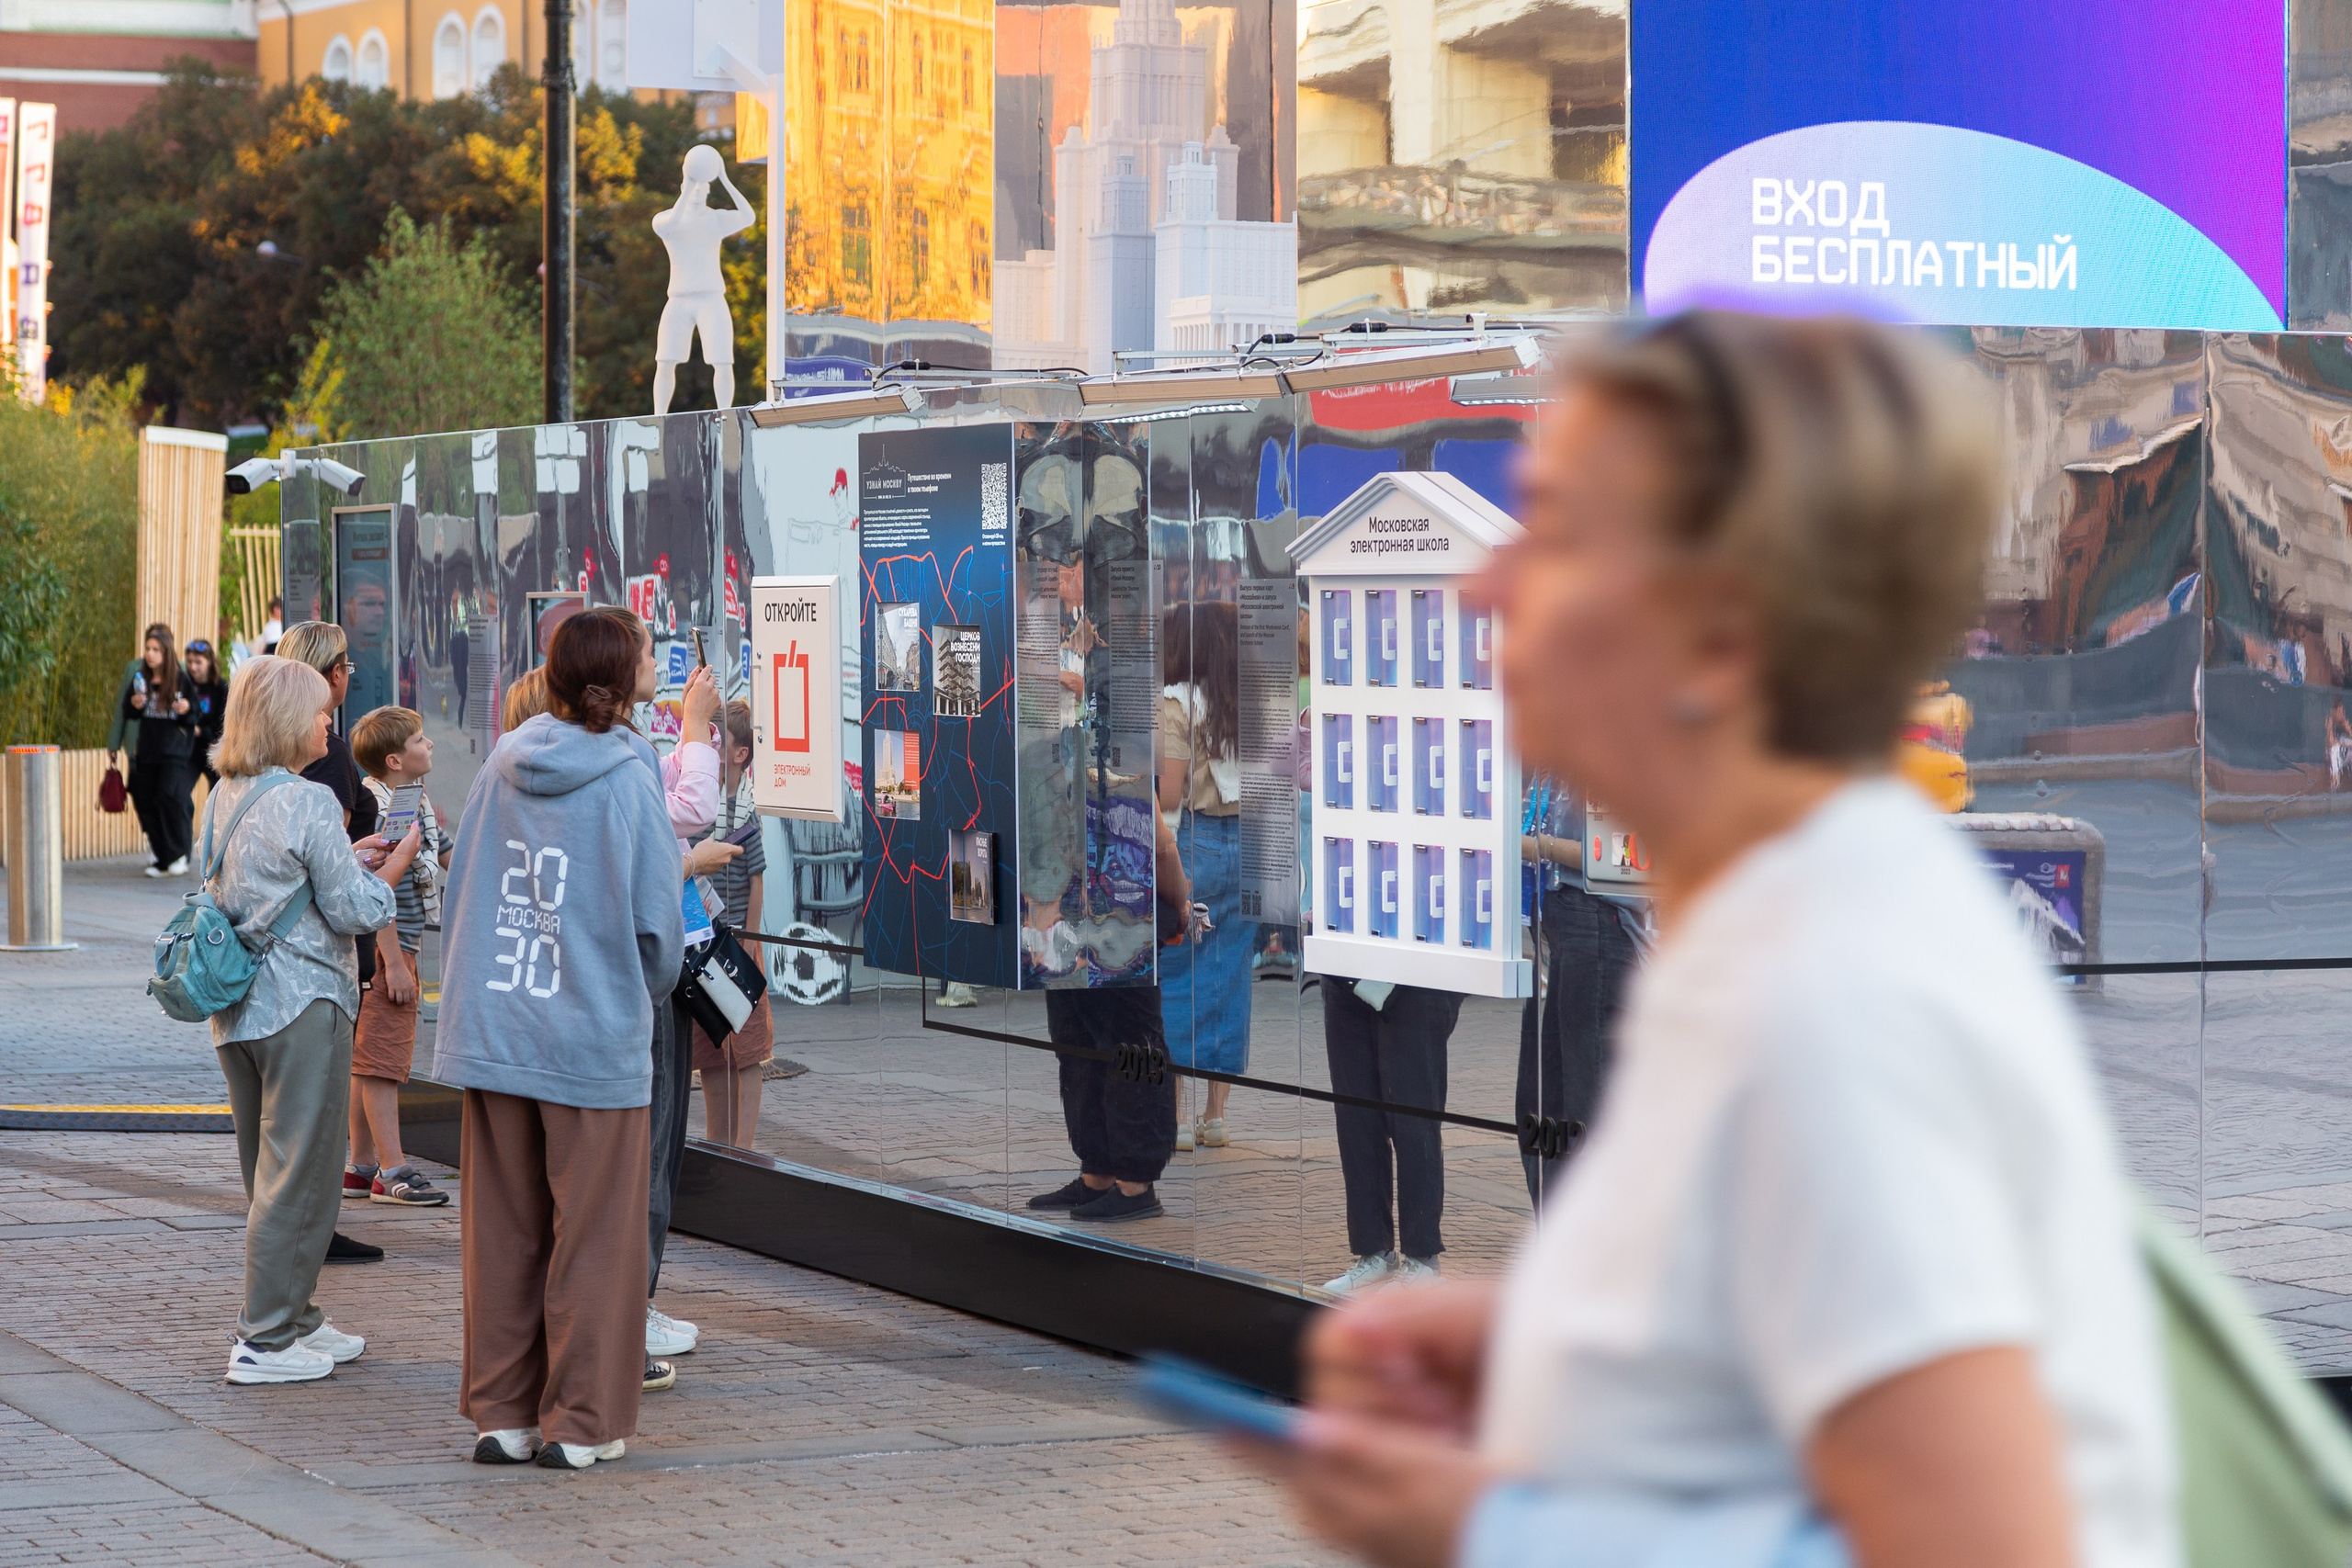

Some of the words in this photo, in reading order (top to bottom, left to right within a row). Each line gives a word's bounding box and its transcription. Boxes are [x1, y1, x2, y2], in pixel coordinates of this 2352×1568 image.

[1752, 177, 1890, 238] ВХОД
[1752, 233, 2077, 290] БЕСПЛАТНЫЙ
[865, 478, 882, 490] УЗНАЙ
[882, 479, 902, 490] МОСКВУ
[1369, 516, 1430, 534] Московская
[1351, 538, 1414, 557] электронная
[1417, 537, 1450, 551] школа
[764, 597, 817, 623] ОТКРОЙТЕ
[950, 642, 980, 652] ВОЗНЕСЕНИ
[960, 631, 980, 642] ЦЕРКОВ
[774, 763, 811, 776] ЭЛЕКТРОННЫЙ
[774, 777, 786, 789] ДОМ
[501, 839, 569, 911] 20
[496, 905, 560, 934] МОСКВА
[485, 927, 560, 998] 30
[1114, 1042, 1165, 1086] 2013
